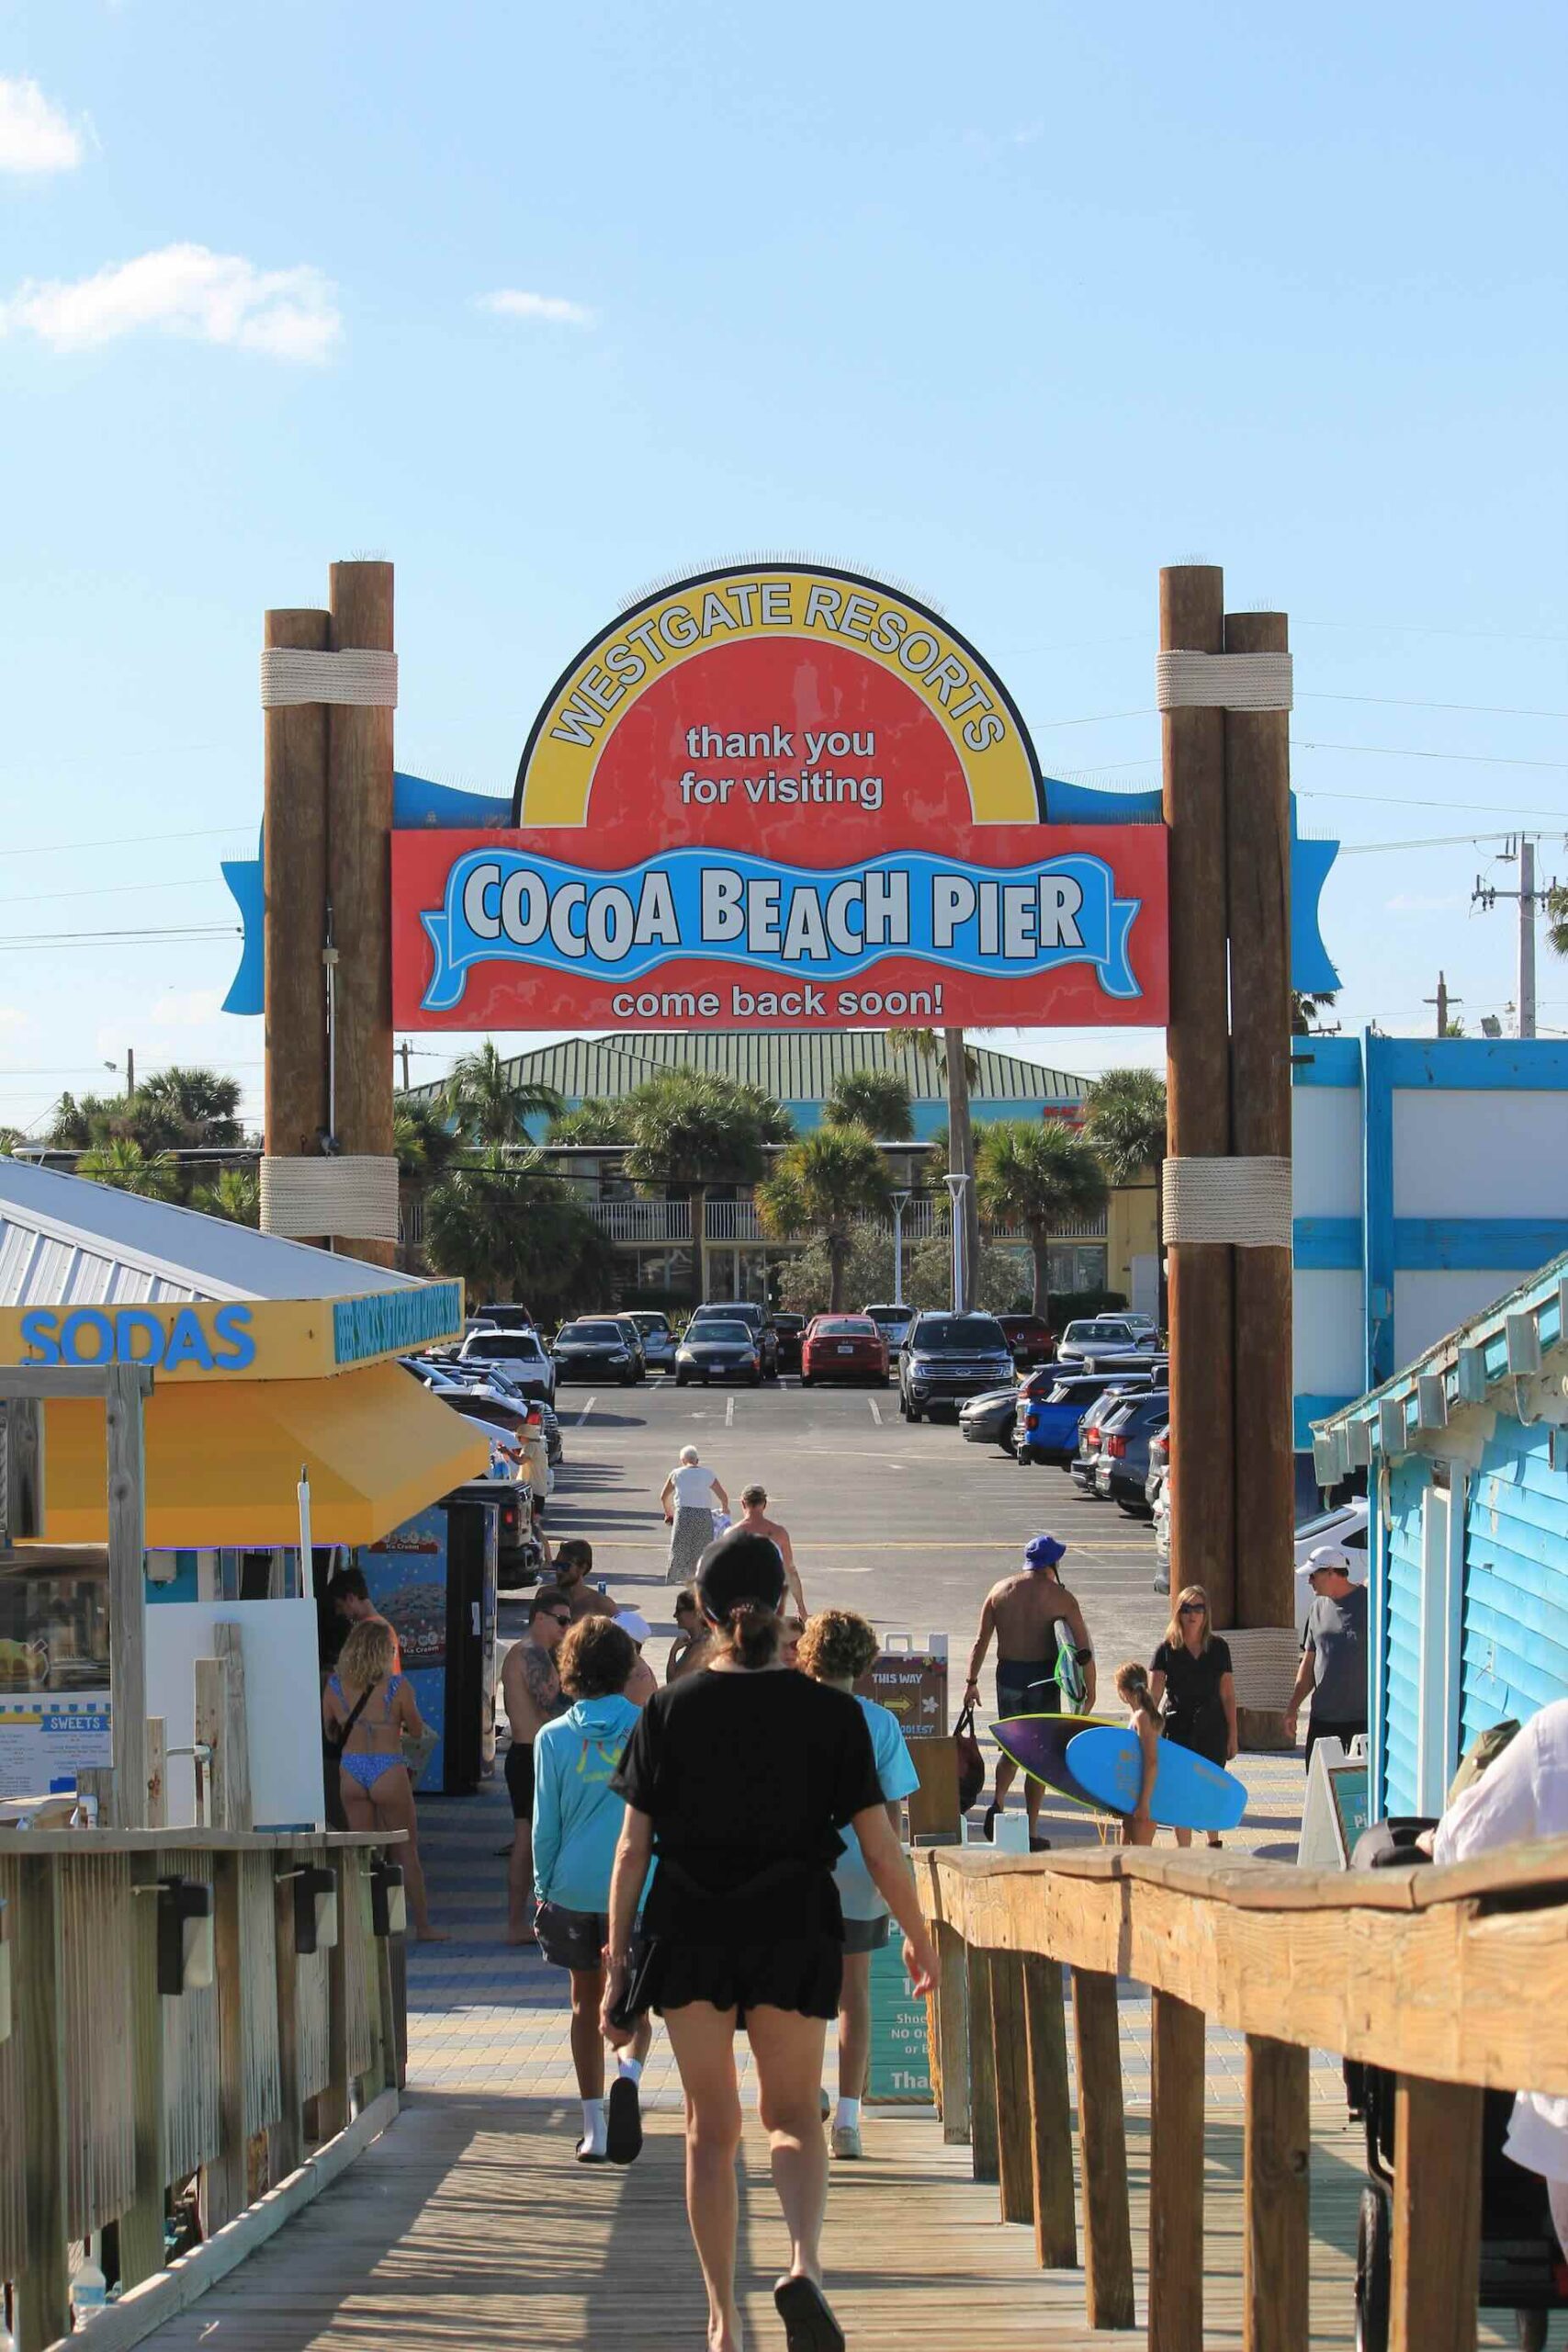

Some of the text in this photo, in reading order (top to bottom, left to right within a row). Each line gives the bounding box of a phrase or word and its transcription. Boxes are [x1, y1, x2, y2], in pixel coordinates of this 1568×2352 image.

[550, 583, 1005, 752] WESTGATE RESORTS
[686, 724, 875, 765] thank you
[680, 770, 883, 810] for visiting
[463, 864, 1085, 962] COCOA BEACH PIER
[612, 984, 943, 1017] come back soon!
[20, 1305, 256, 1371] SODAS
[872, 1673, 923, 1684] THIS WAY
[51, 1716, 100, 1730] SWEETS
[891, 2029, 909, 2039] NO
[905, 2045, 918, 2054] or
